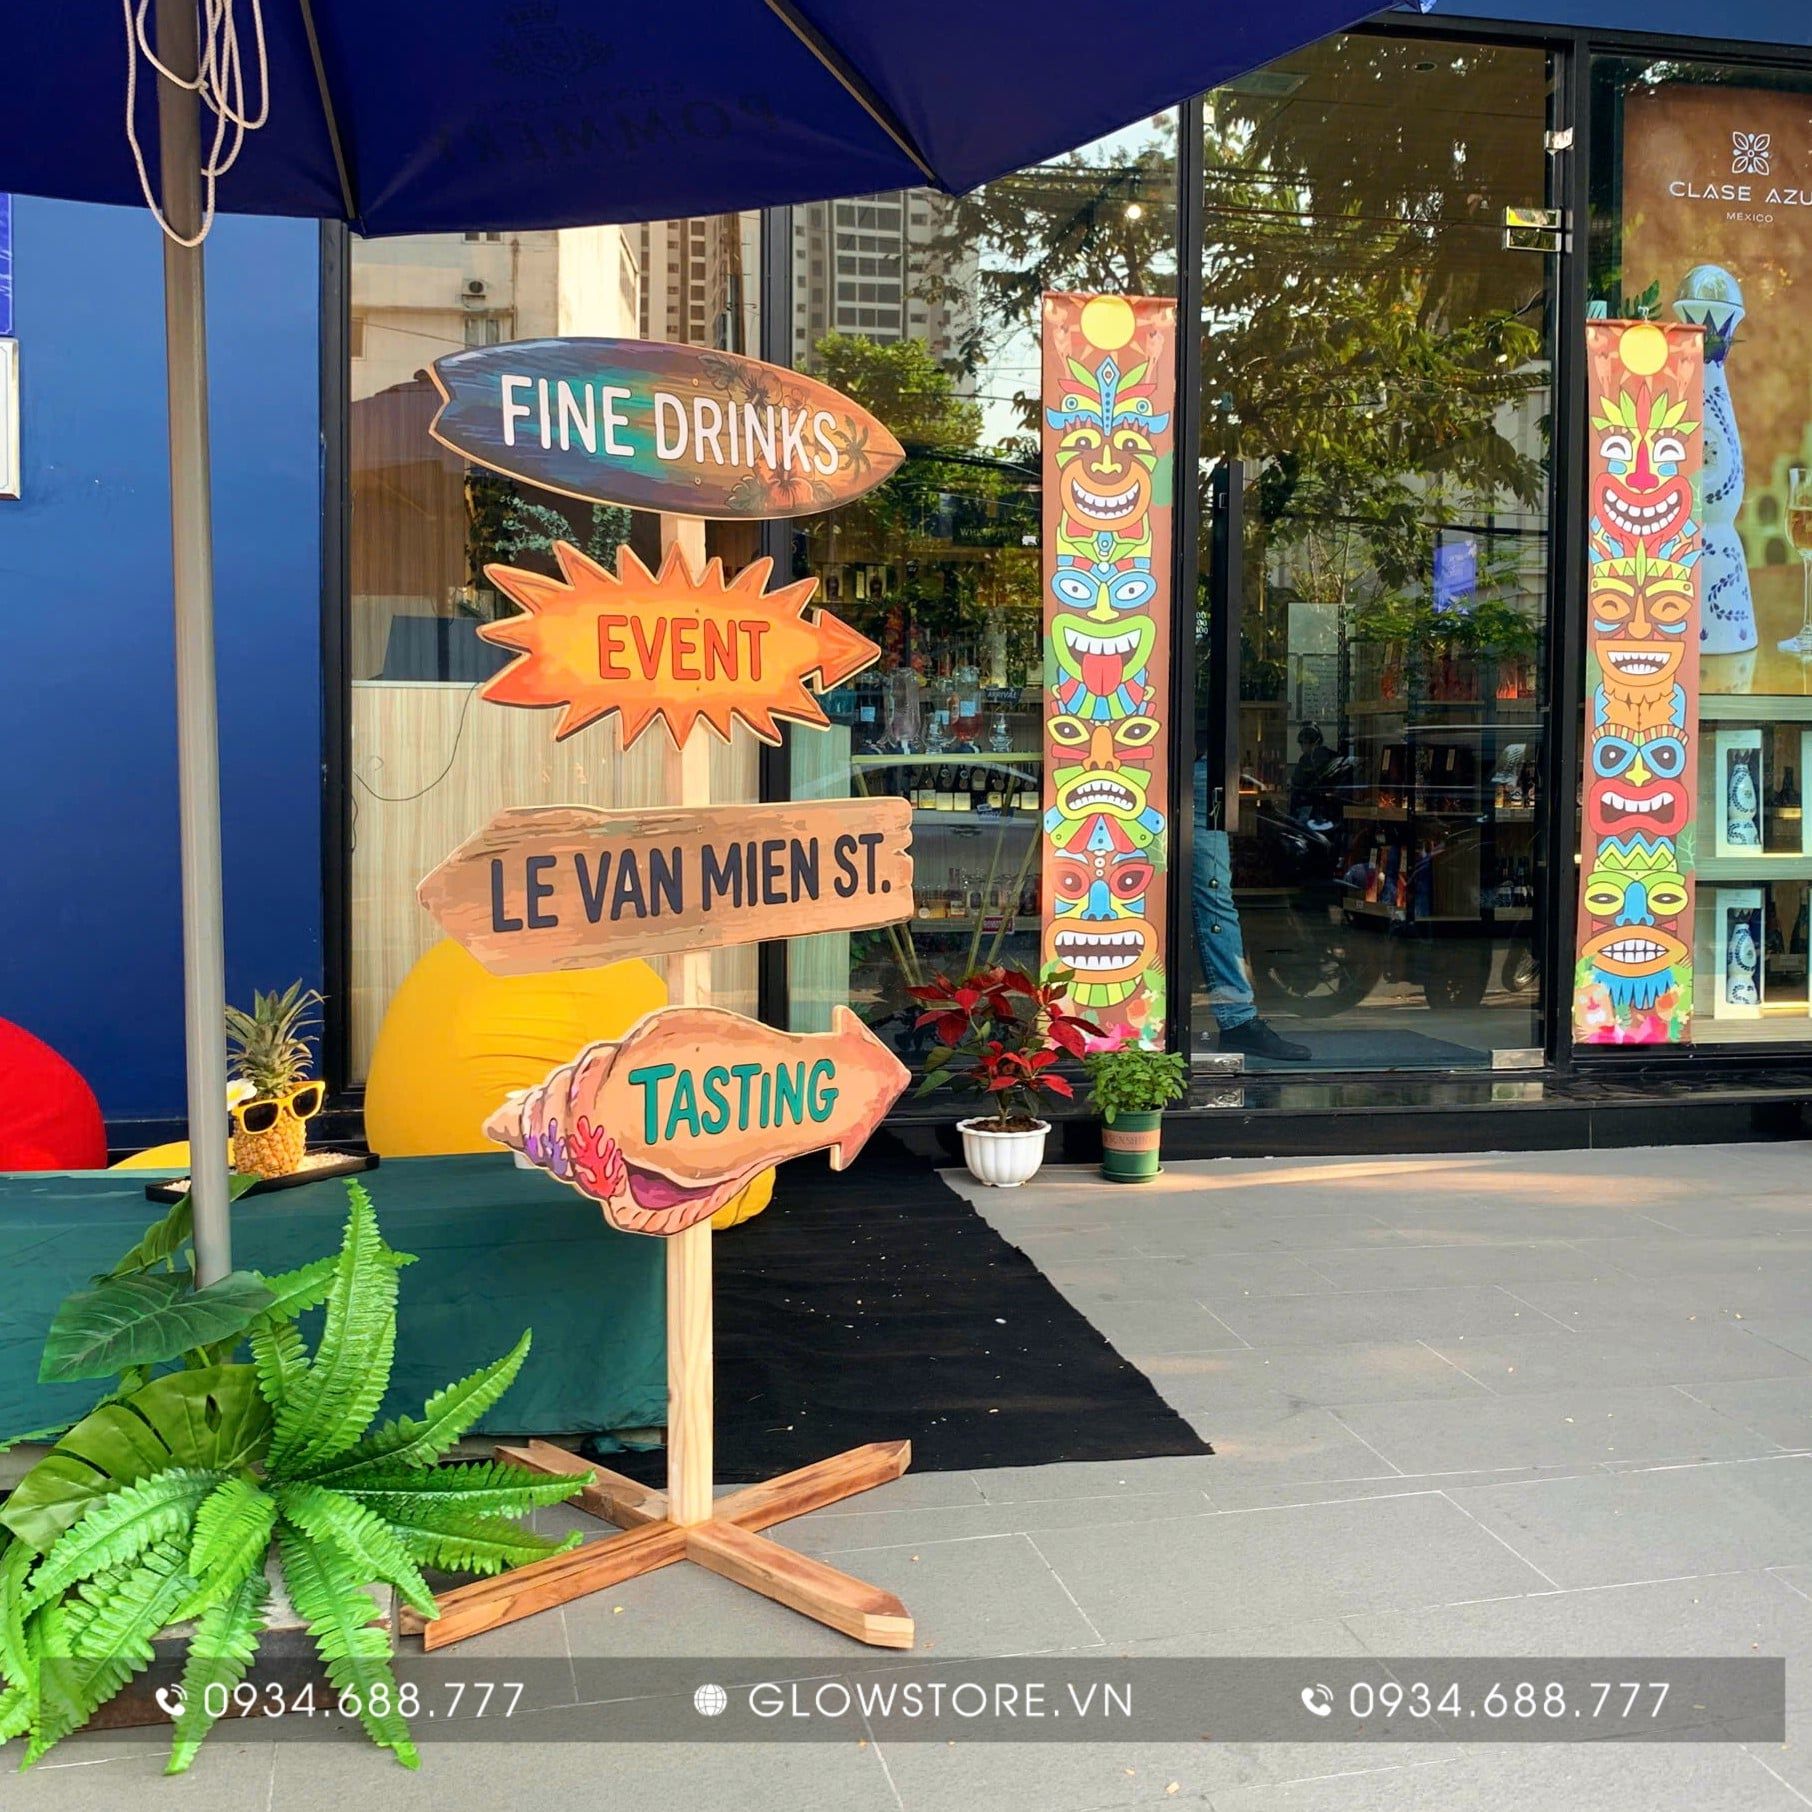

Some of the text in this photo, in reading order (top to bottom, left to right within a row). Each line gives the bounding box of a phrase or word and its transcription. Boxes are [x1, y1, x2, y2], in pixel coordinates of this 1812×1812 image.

[1669, 181, 1752, 203] CLASE
[1726, 212, 1774, 223] MEXICO
[500, 374, 839, 475] FINE DRINKS
[597, 615, 770, 682] EVENT
[490, 833, 892, 932] LE VAN MIEN ST.
[628, 1058, 839, 1146] TASTING
